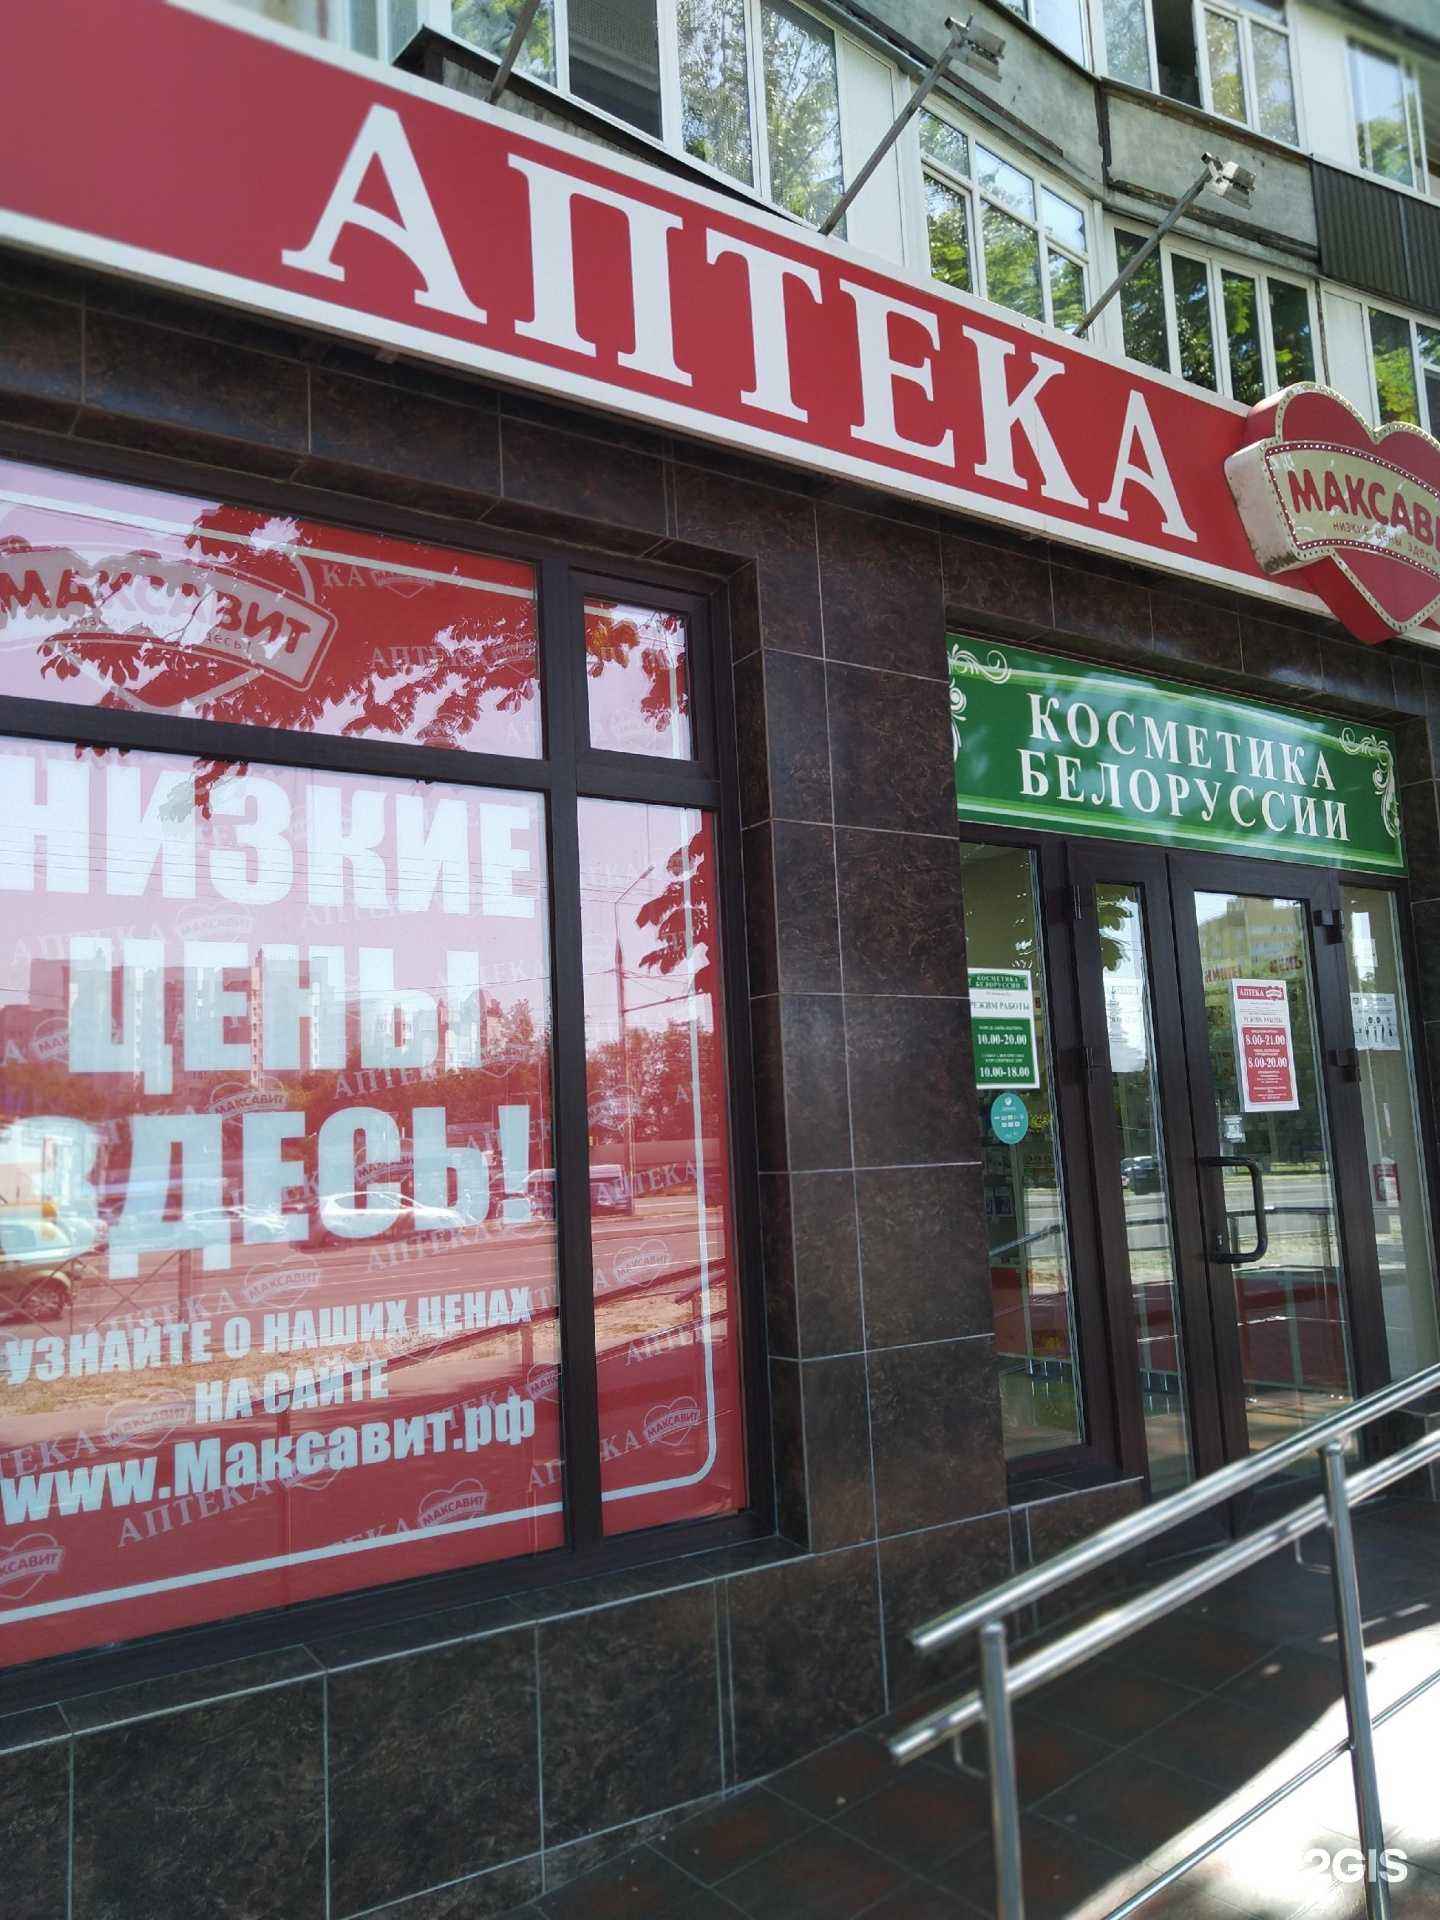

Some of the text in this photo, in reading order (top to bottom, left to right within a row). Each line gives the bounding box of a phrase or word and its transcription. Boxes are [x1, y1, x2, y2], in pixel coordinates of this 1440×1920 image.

[281, 103, 1197, 543] АПТЕКА
[1287, 468, 1440, 553] МАКСАВ
[1026, 692, 1337, 792] КОСМЕТИКА
[0, 755, 536, 918] НИЗКИЕ
[1018, 749, 1351, 842] БЕЛОРУССИИ
[69, 937, 481, 1095] ЦЕНЫ
[977, 1033, 1027, 1045] 10.00-20.00
[980, 1066, 1030, 1078] 10.00-18.00
[5, 1318, 213, 1386] УЗНАЙТЕ
[224, 1317, 252, 1361] О
[263, 1300, 407, 1354] НАШИХ
[418, 1287, 532, 1338] ЦЕНАХ
[195, 1377, 253, 1424] НА
[263, 1359, 391, 1415] САЙТЕ
[1, 1394, 536, 1526] www.Максавит.рф
[118, 1477, 274, 1548] АПТЕКА
[423, 1495, 485, 1526] МАКСАВИТ
